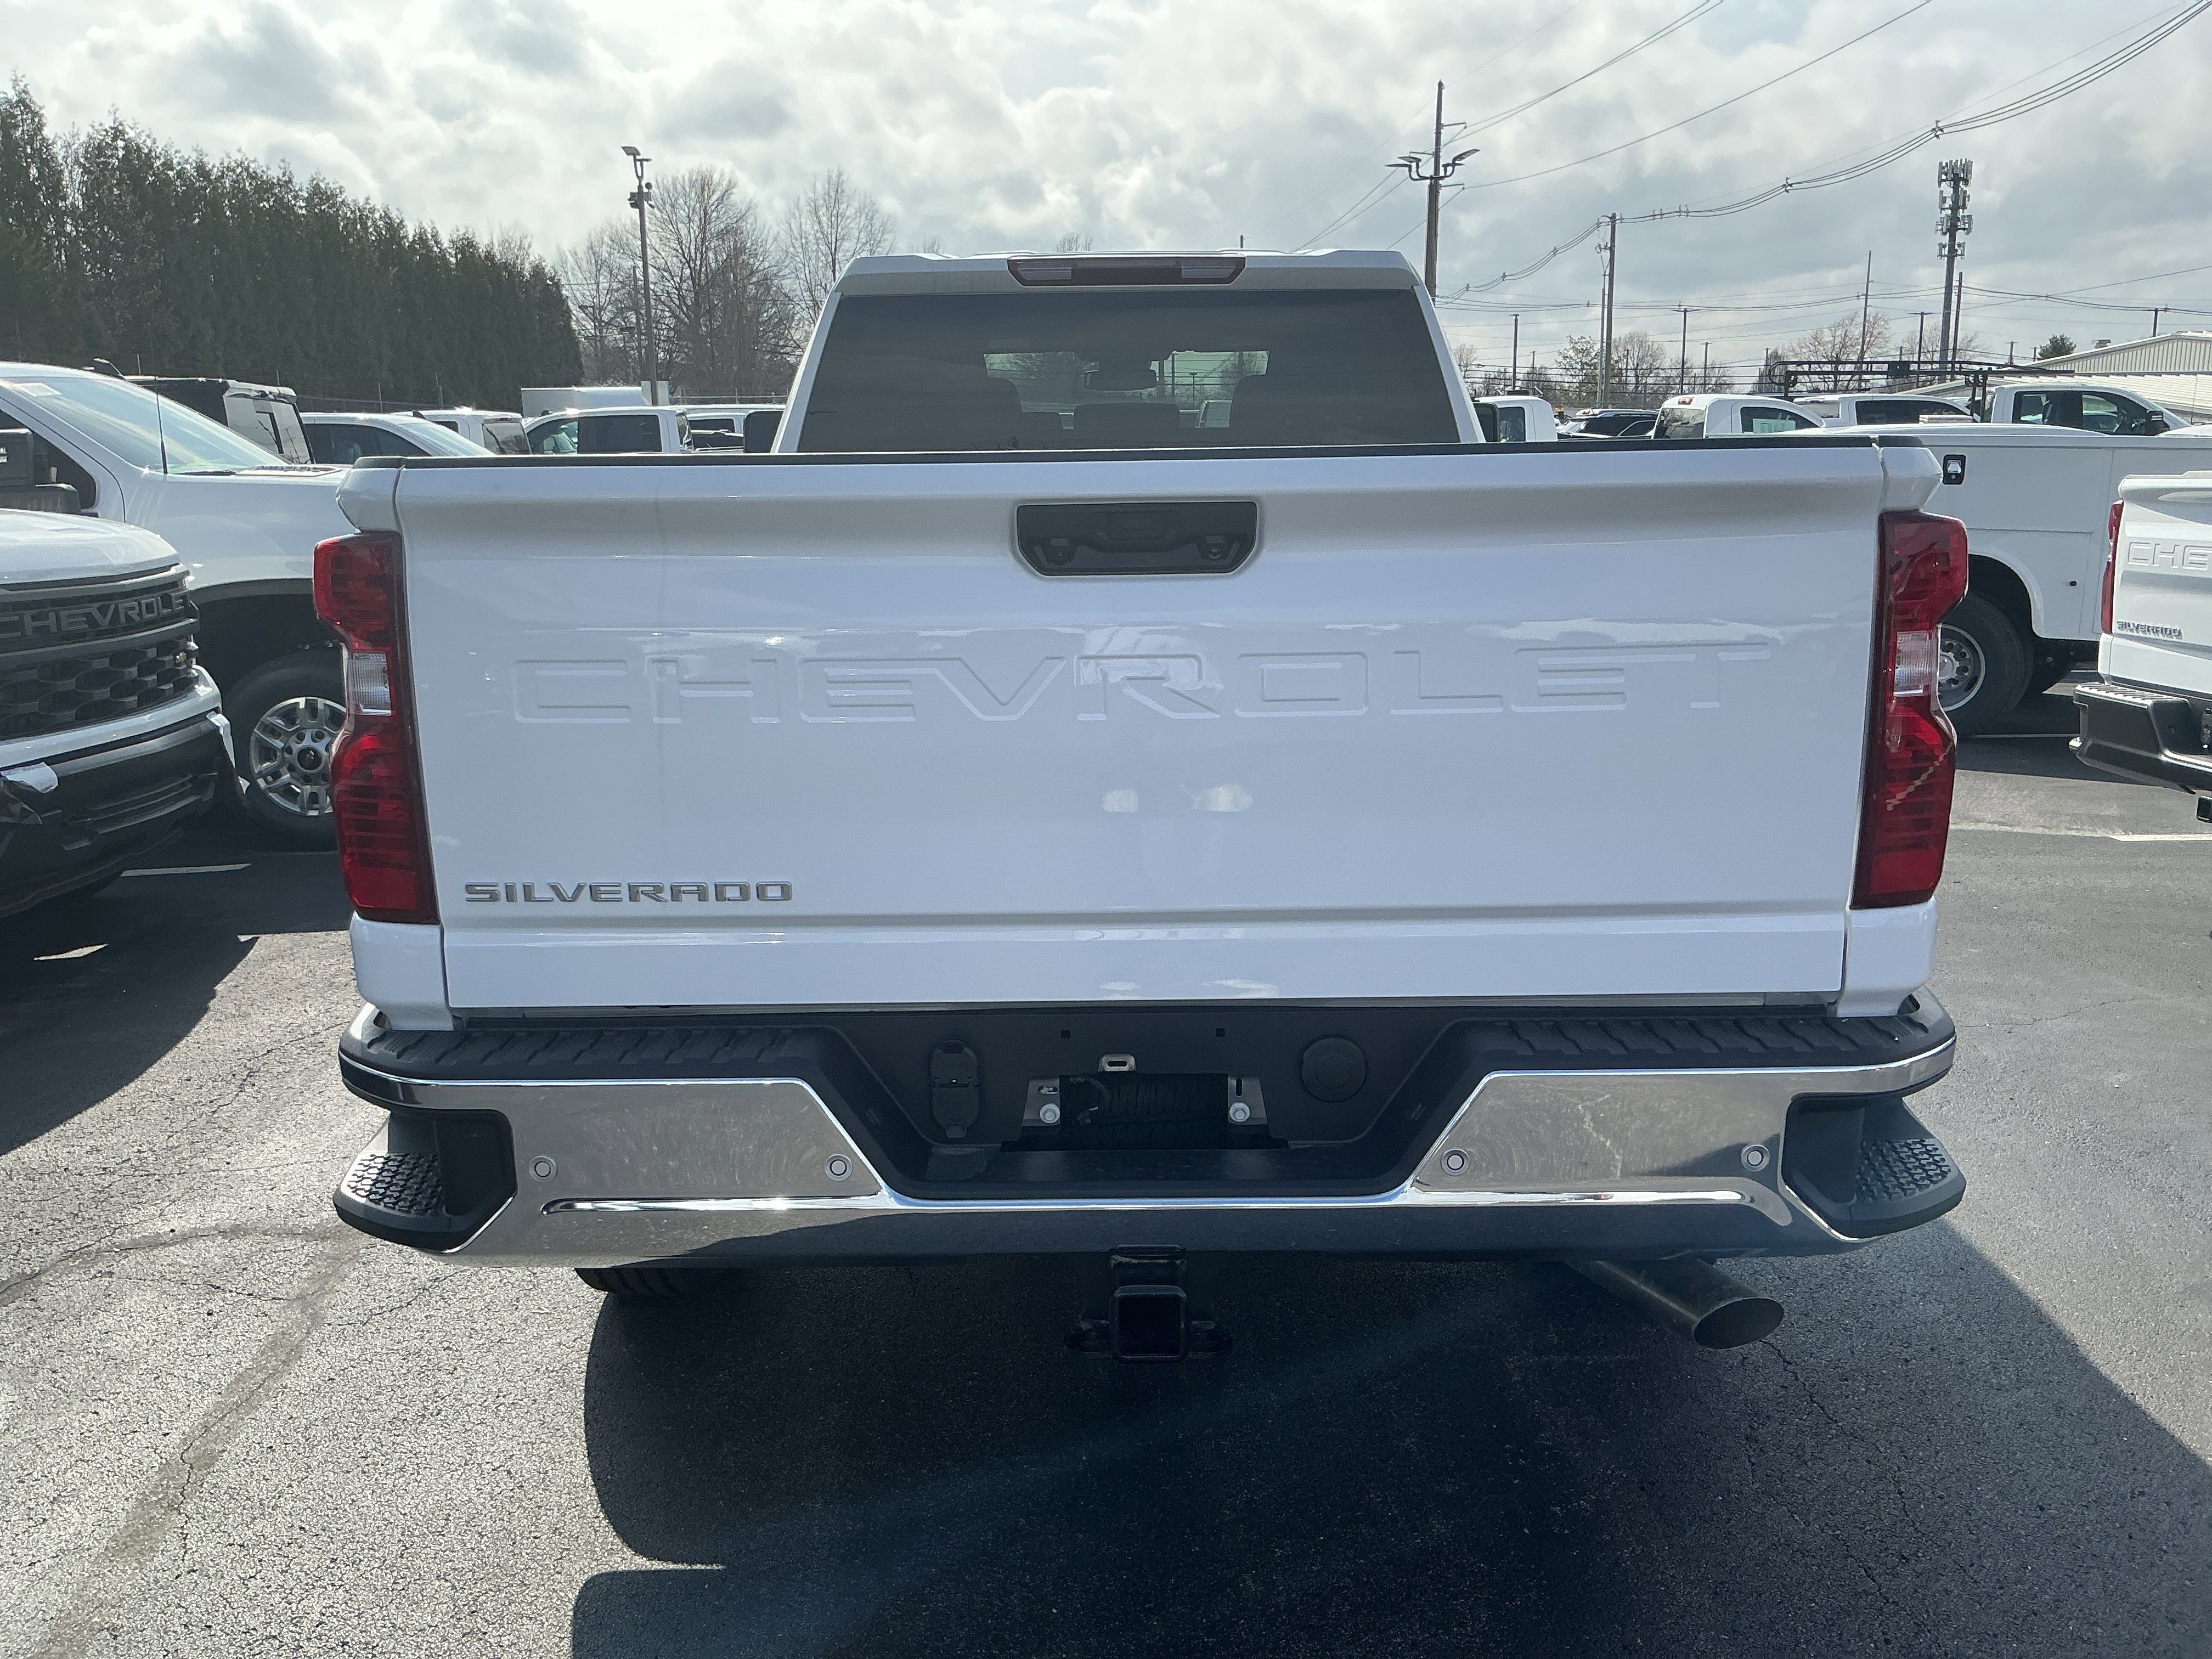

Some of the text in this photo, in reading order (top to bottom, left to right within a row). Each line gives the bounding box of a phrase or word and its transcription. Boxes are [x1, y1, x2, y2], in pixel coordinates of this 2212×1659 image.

[2116, 620, 2183, 639] SILVERADO
[512, 642, 1772, 724] CHEVROLET
[465, 881, 793, 902] SILVERADO
